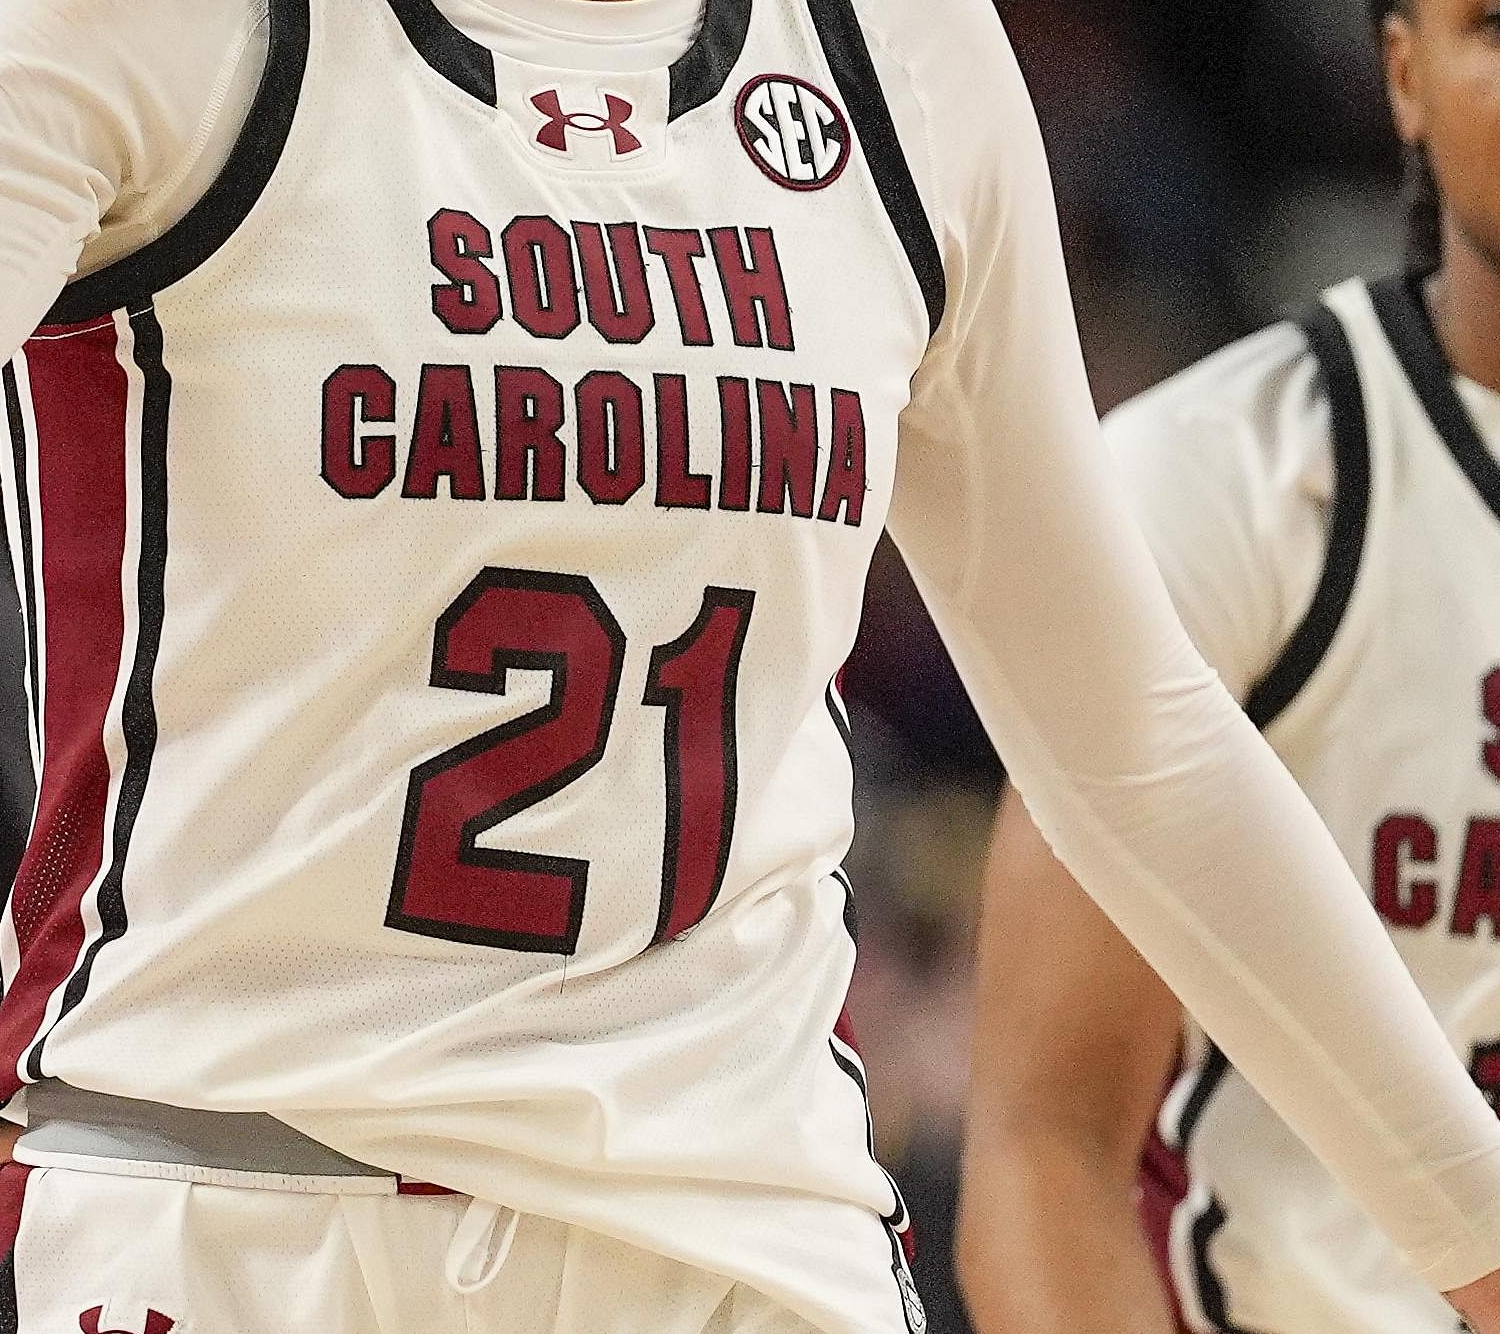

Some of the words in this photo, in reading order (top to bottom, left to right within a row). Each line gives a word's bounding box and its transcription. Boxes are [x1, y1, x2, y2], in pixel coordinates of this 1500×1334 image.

[743, 80, 844, 182] SEC
[427, 208, 795, 352] SOUTH
[320, 364, 868, 527] CAROLINA
[383, 566, 756, 957] 21
